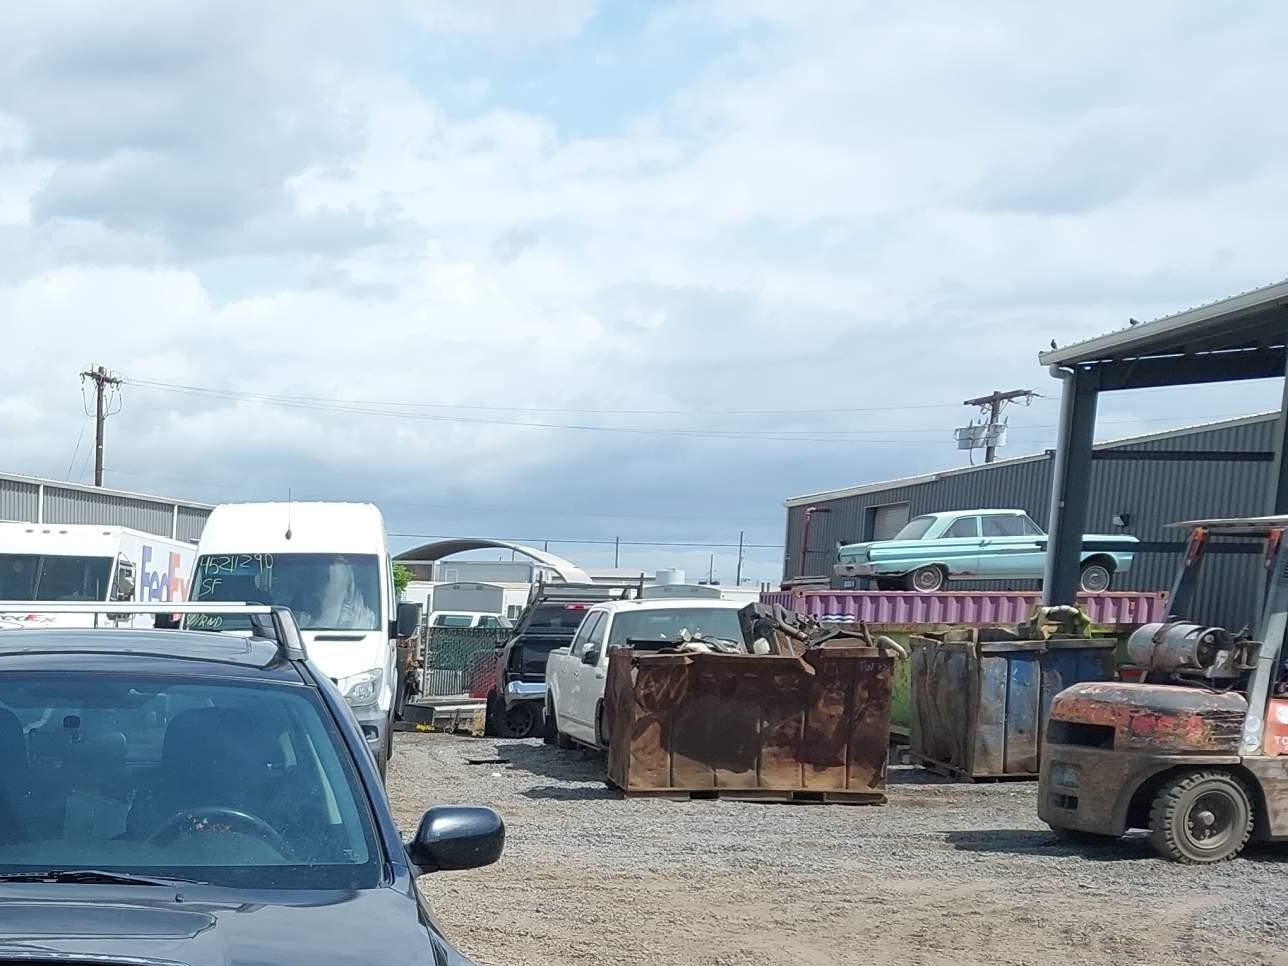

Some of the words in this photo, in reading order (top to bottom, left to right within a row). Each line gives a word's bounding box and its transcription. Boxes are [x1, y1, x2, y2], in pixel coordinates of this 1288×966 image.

[140, 545, 191, 603] FedEx
[199, 553, 274, 576] 45211290
[199, 578, 223, 598] SF
